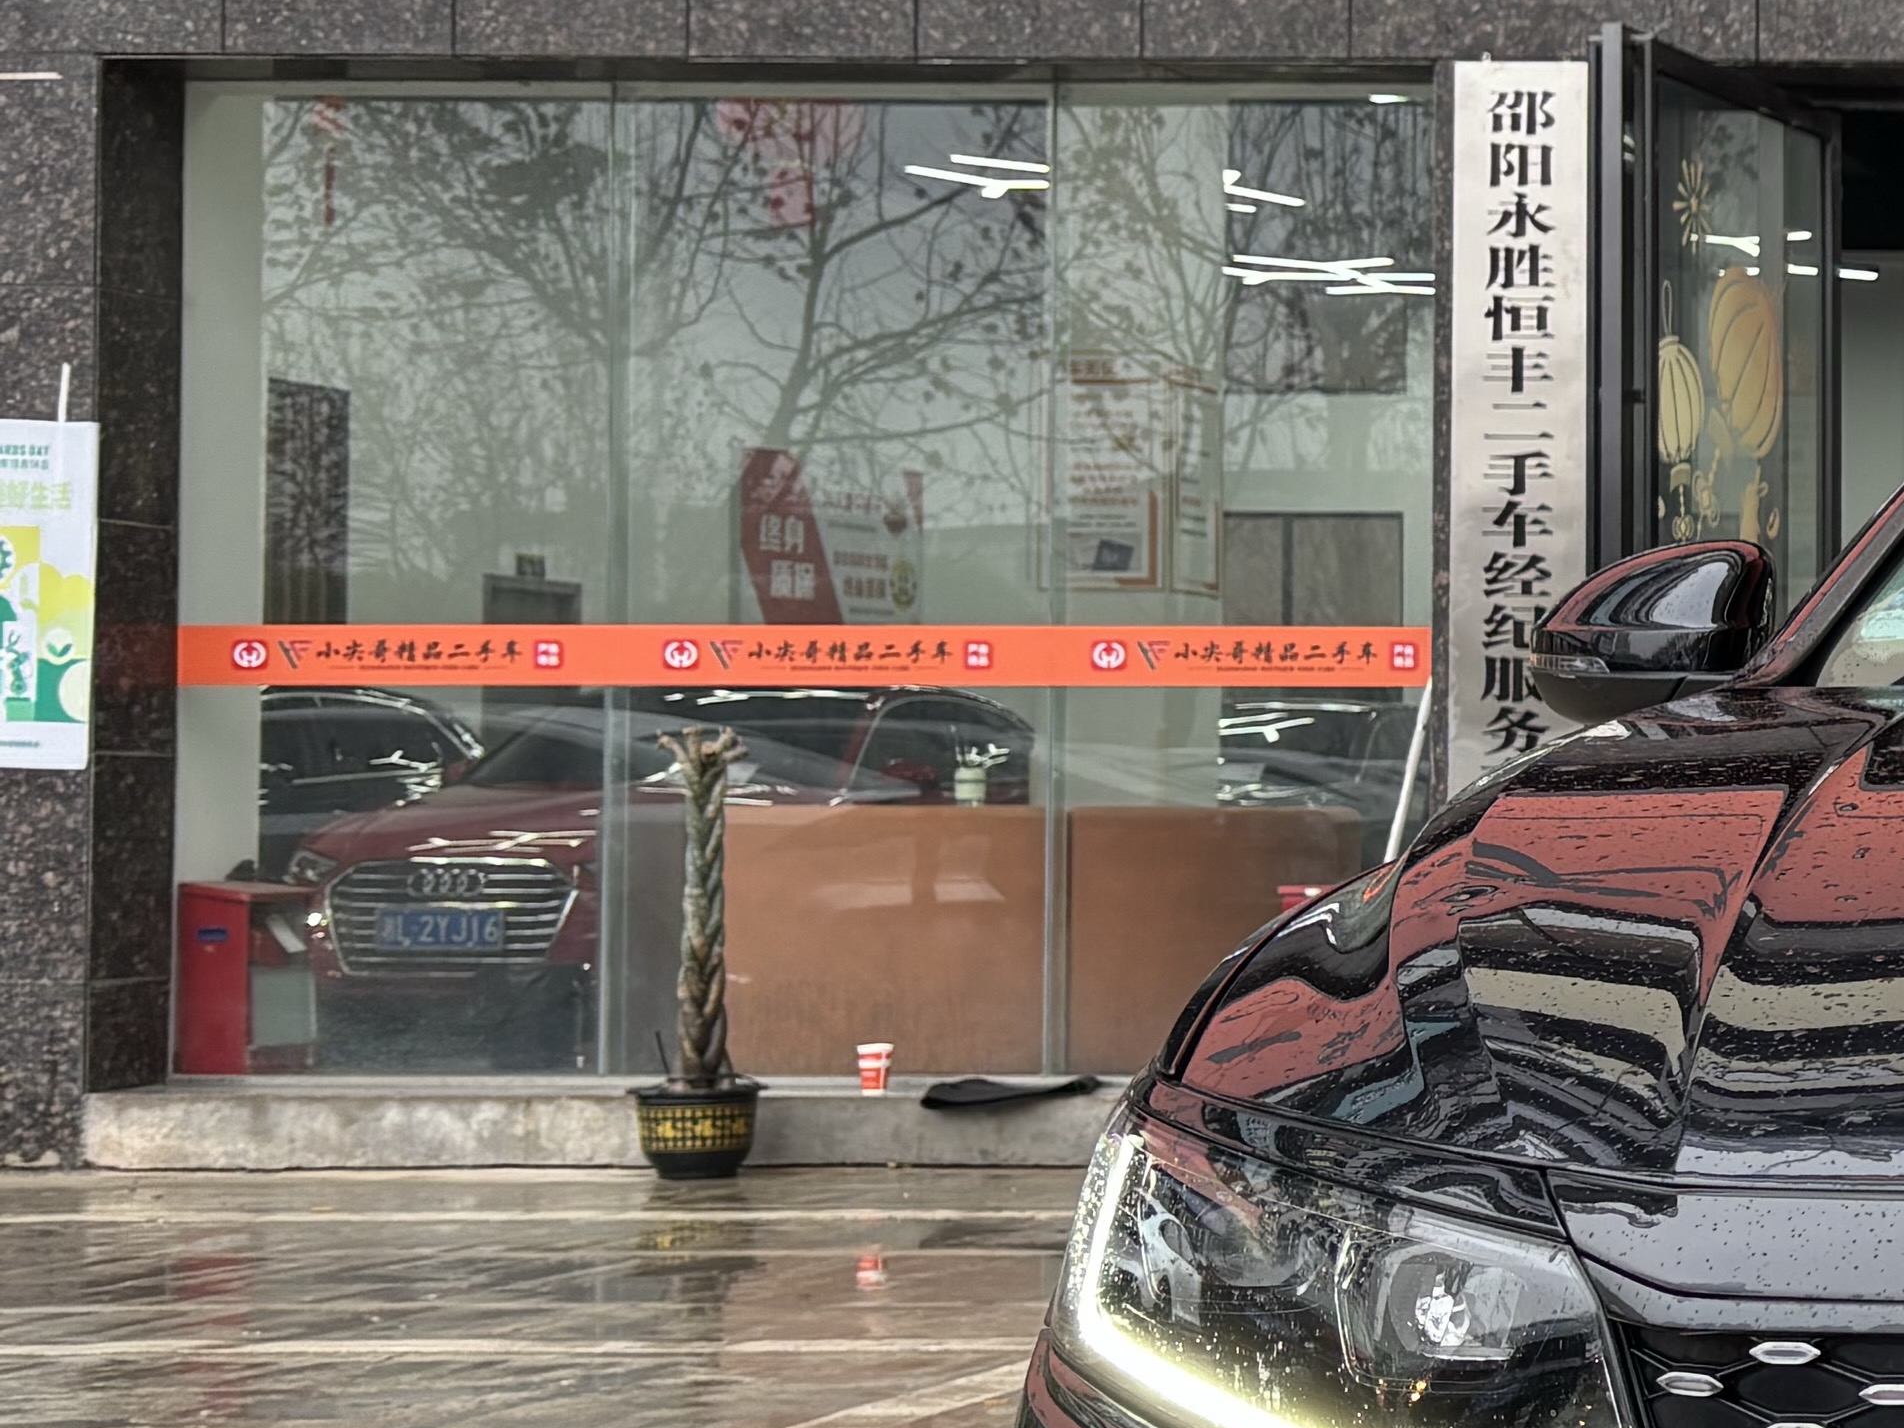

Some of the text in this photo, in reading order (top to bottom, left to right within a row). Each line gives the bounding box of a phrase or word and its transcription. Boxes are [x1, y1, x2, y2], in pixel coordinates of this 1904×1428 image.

[0, 479, 73, 510] 好生活
[1479, 87, 1557, 770] 邵阳永胜恒丰二手车经纪服务
